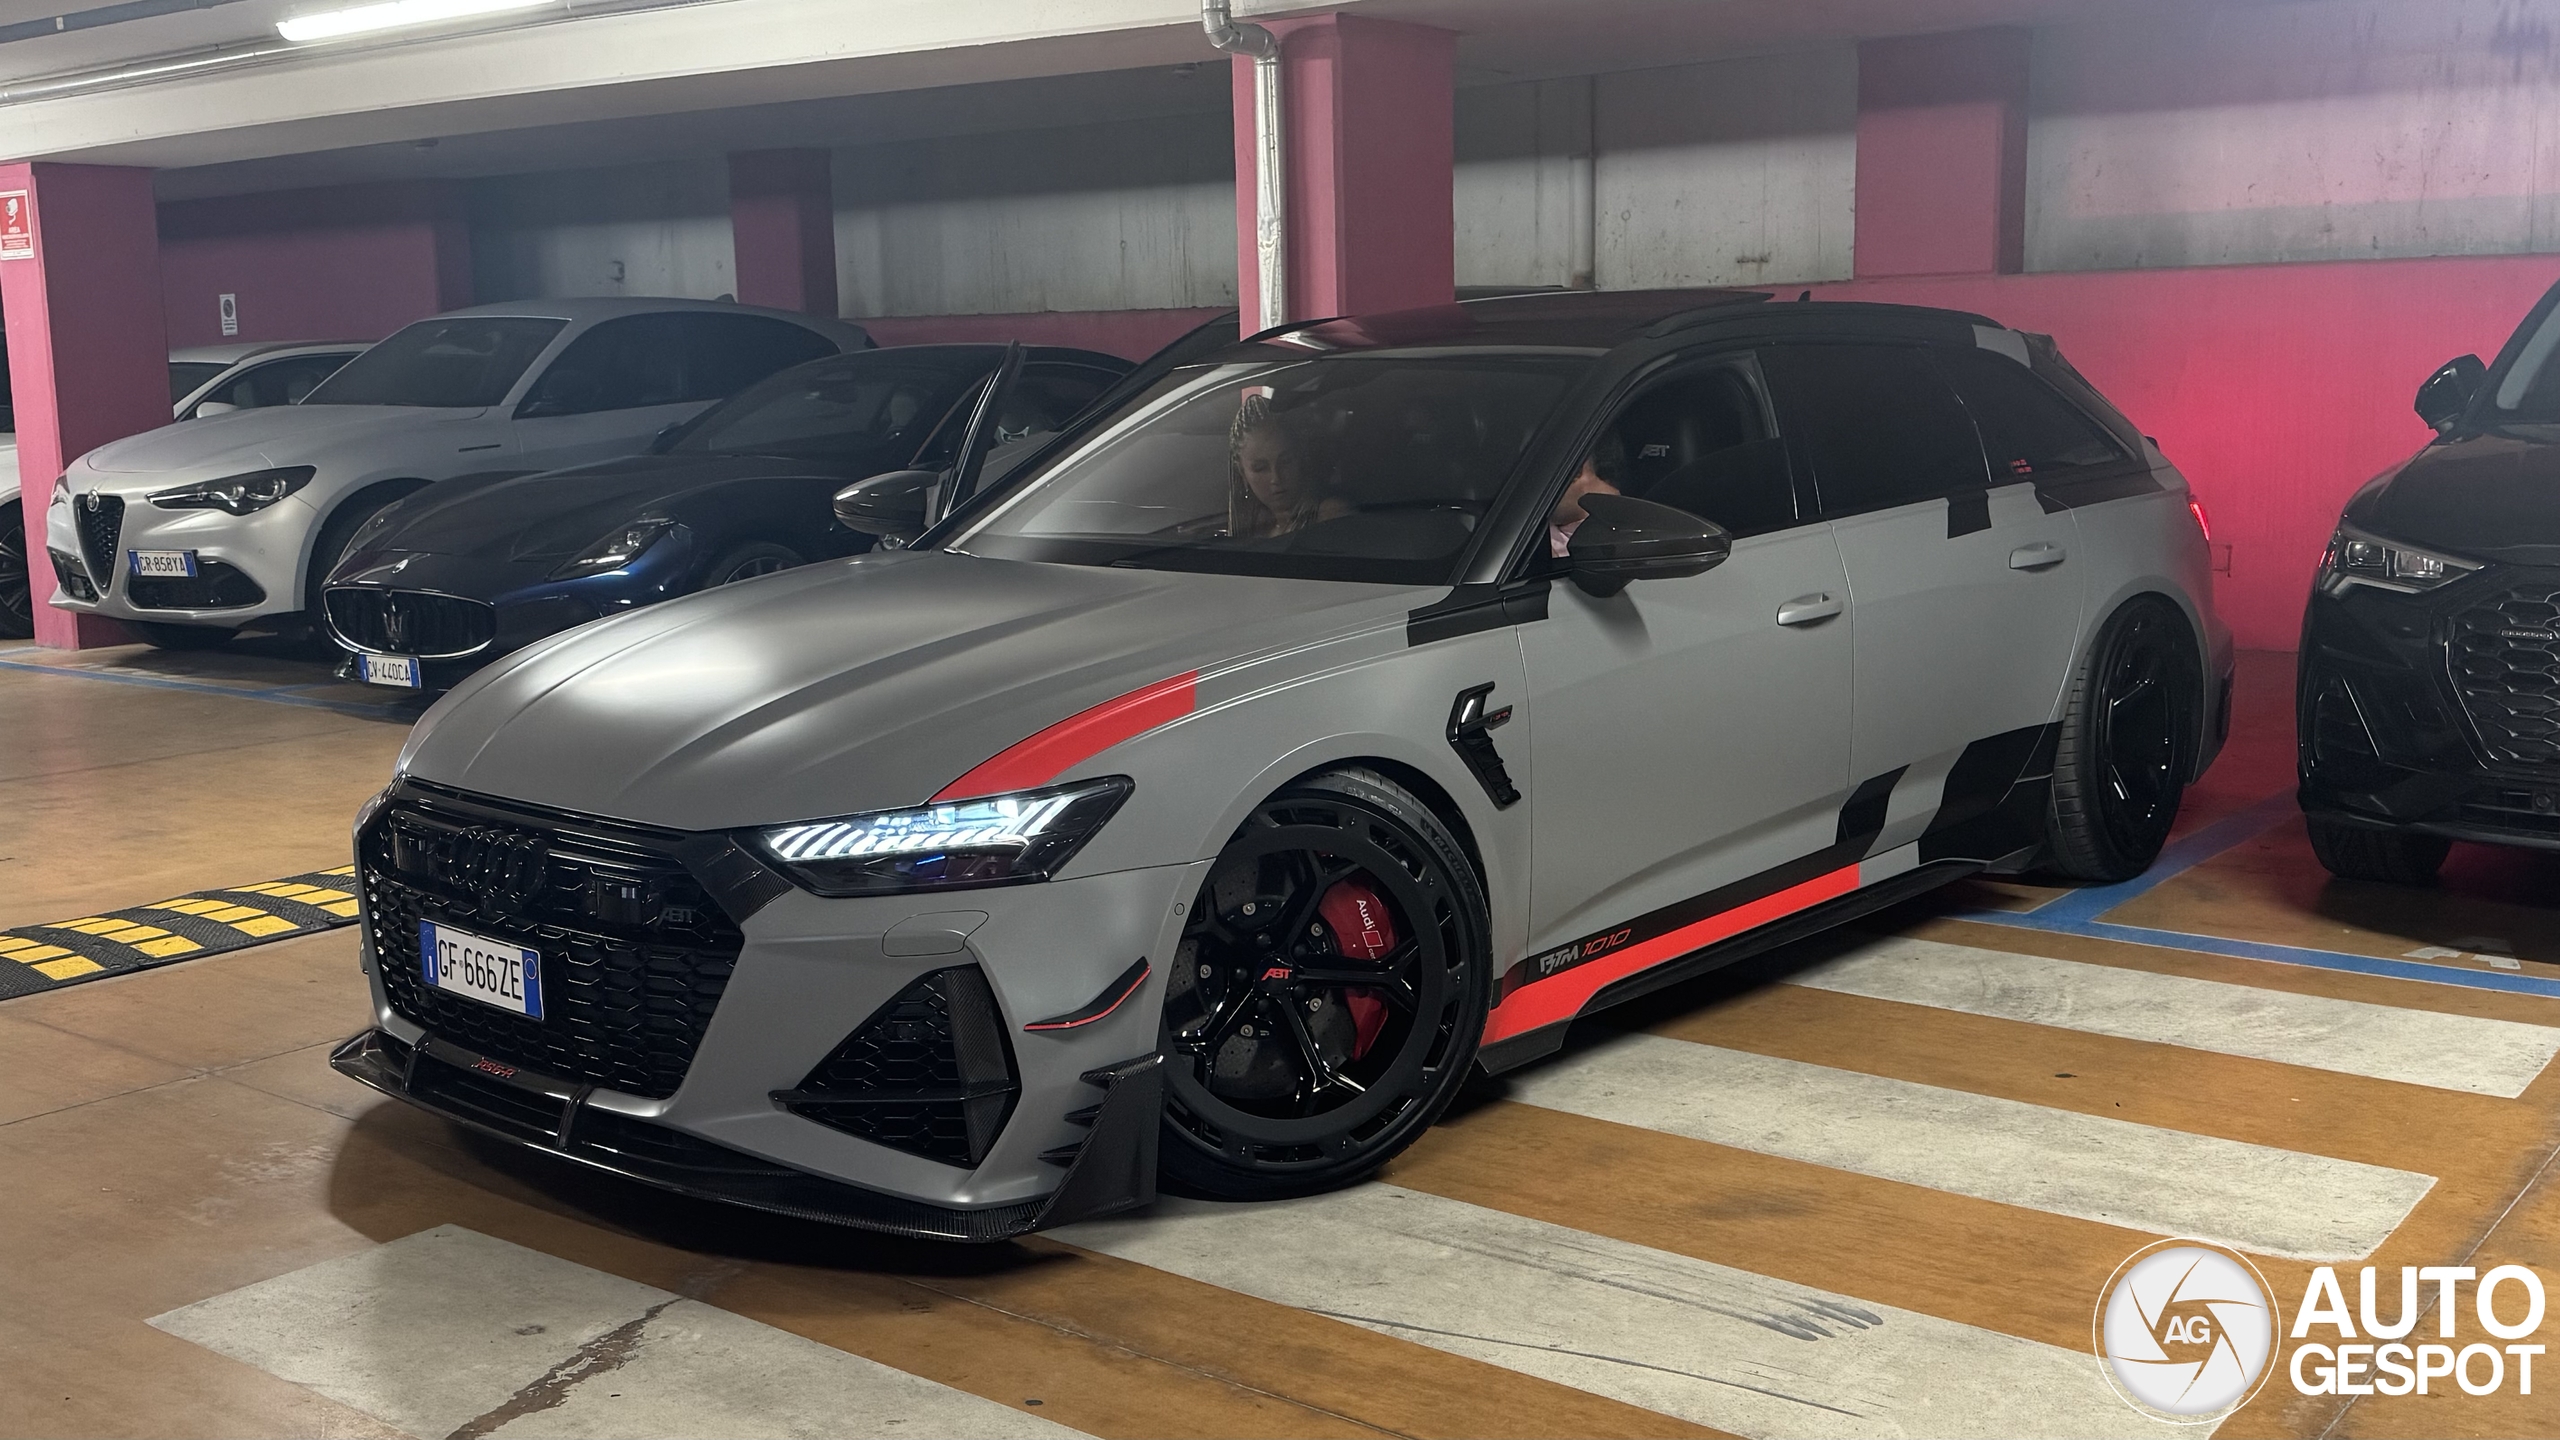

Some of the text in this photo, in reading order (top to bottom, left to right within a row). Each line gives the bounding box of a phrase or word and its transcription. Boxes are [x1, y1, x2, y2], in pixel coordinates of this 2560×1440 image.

[1637, 444, 1670, 459] ABT
[1356, 899, 1376, 930] Audi
[1581, 928, 1632, 957] 1010
[438, 939, 523, 1001] GF 666ZE
[1261, 967, 1293, 981] ABT
